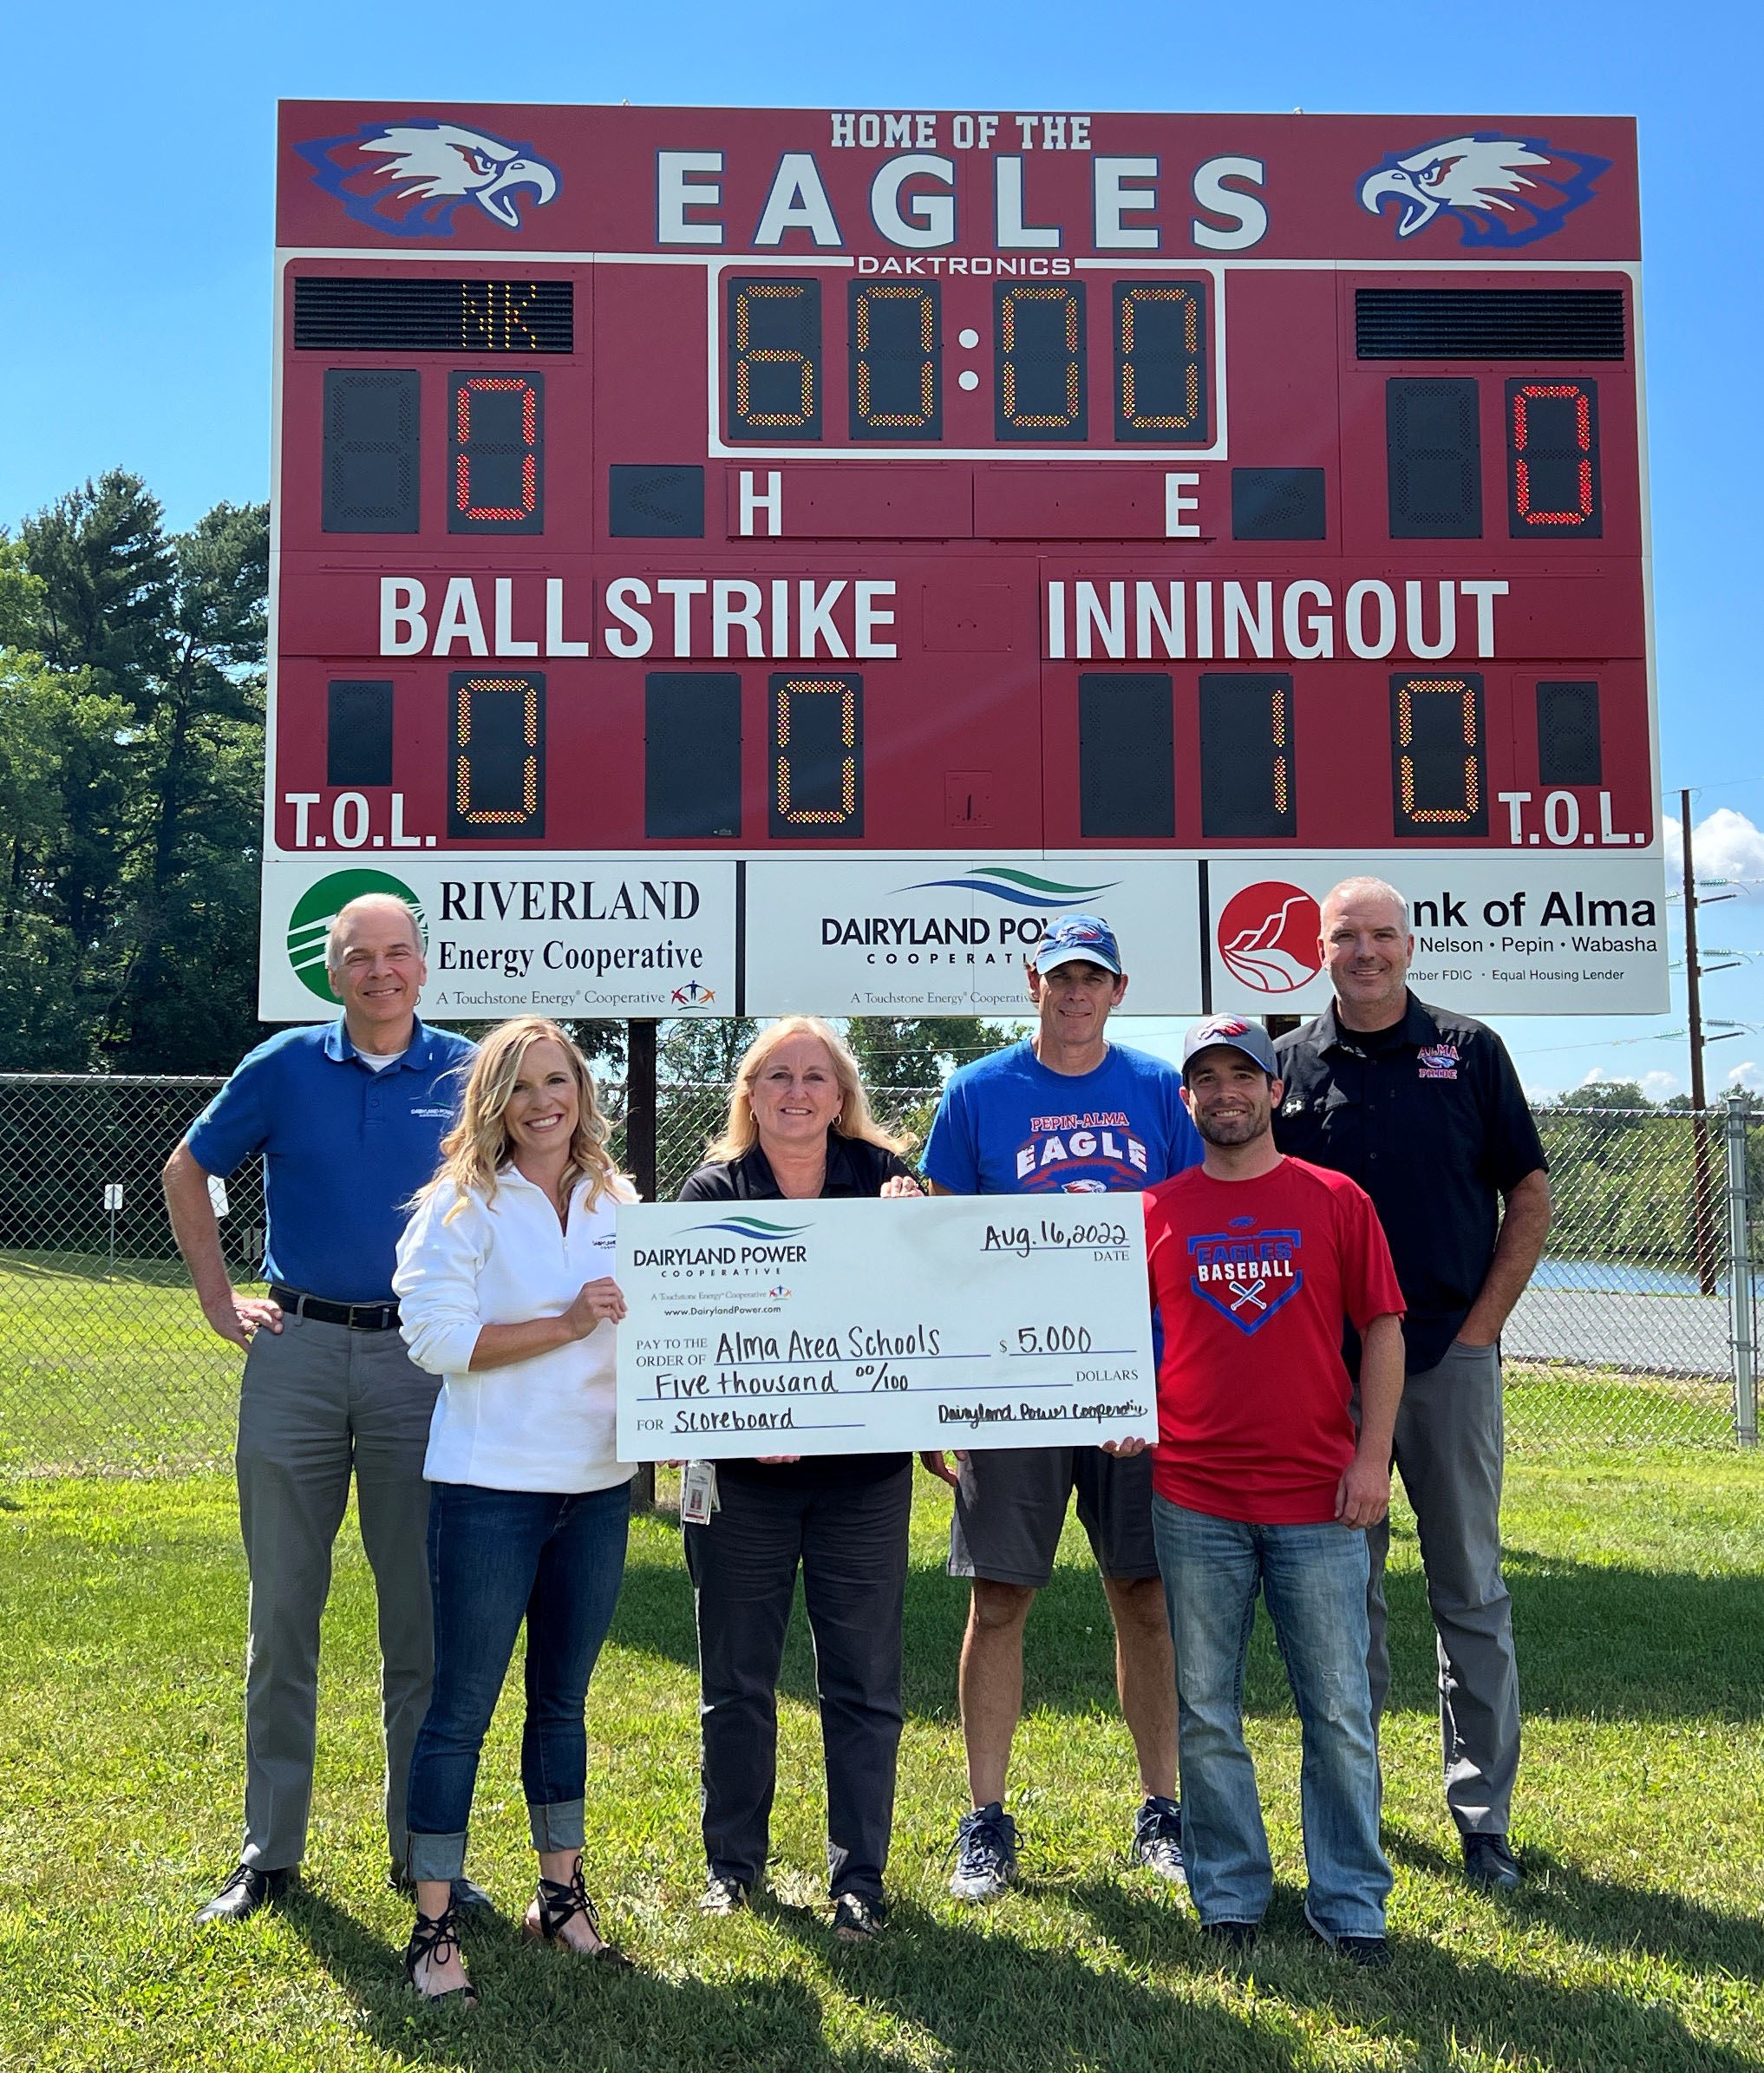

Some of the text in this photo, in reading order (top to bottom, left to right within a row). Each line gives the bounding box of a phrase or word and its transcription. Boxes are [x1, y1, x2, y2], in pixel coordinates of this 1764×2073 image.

[831, 114, 1092, 150] HOME OF THE
[657, 150, 1269, 251] EAGLES
[859, 256, 1072, 276] DAKTRONICS
[456, 378, 536, 520] 0
[1513, 385, 1593, 525] 0
[740, 471, 781, 536] H
[1165, 473, 1199, 537] E
[379, 577, 590, 657] BALL
[604, 577, 898, 659] STRIKE
[1049, 579, 1335, 660] INNING
[1344, 579, 1510, 659] OUT
[456, 678, 538, 824] 0
[778, 680, 856, 824] 0
[1398, 678, 1480, 823] 0
[284, 792, 438, 848] T.O.L.
[1499, 791, 1646, 846] T.O.L.
[438, 880, 701, 921] RIVERLAND
[1408, 891, 1657, 928] nk of Alma
[821, 918, 990, 945] DAIRYLAND
[438, 939, 704, 978] Energy Cooperative
[866, 952, 1027, 965] COOPERATI
[1421, 937, 1657, 956] Nelson Pepin Wabasha
[1406, 969, 1624, 983] mber FDIC Equal Housing Lender
[436, 992, 448, 1004] A
[454, 991, 527, 1004] Touchstone
[585, 991, 666, 1006] Cooperative
[851, 993, 861, 1004] A
[865, 992, 924, 1004] Touchstone
[970, 991, 1030, 1005] Cooperativ
[1416, 1043, 1460, 1062] ALMA
[1419, 1068, 1458, 1080] PRIDE
[1030, 1111, 1130, 1132] PEPIN-ALMA
[1016, 1131, 1147, 1180] EAGLE
[634, 1246, 807, 1266] DAIRYLAND POWER
[985, 1226, 1036, 1258] Aug.
[1094, 1251, 1130, 1261] DATE
[1198, 1242, 1292, 1265] EAGLES
[661, 1267, 781, 1278] COOPERATIVE
[1198, 1260, 1293, 1282] BASEBALL
[664, 1305, 781, 1318] www.DairylandPower.com
[637, 1338, 708, 1350] PAY TO THE
[716, 1324, 940, 1363] Alma Area Schools
[637, 1355, 707, 1368] ORDER OF
[656, 1373, 709, 1399] Five
[717, 1370, 839, 1395] thousand
[1075, 1370, 1139, 1382] DOLLARS
[637, 1419, 663, 1431] FOR
[674, 1408, 797, 1433] Scoreboard
[1020, 1403, 1067, 1420] Power
